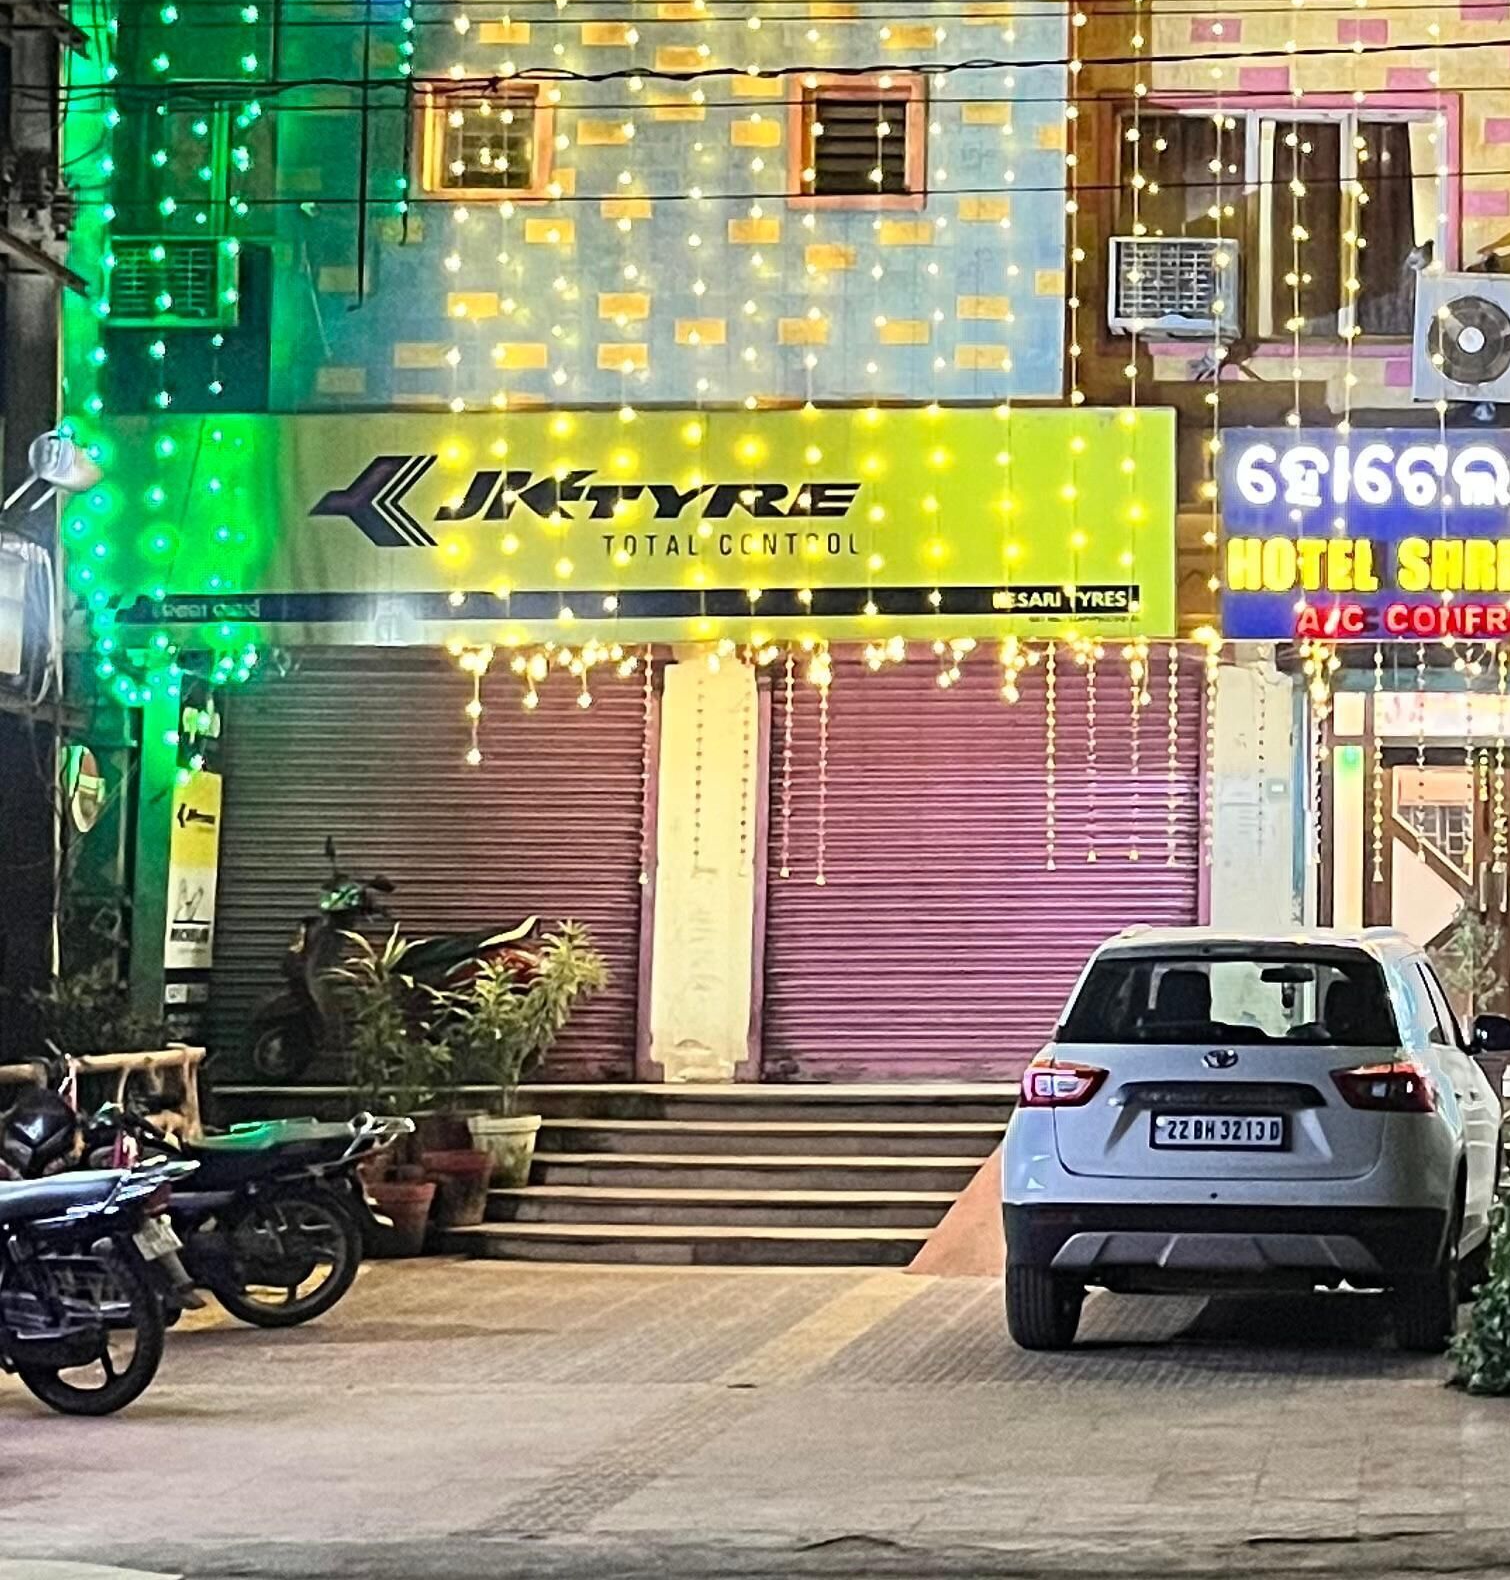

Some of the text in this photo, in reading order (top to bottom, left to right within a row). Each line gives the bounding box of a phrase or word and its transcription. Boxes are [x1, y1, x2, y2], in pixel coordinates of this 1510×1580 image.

[1236, 444, 1510, 507] ହୋଟେଲ
[602, 534, 699, 557] TOTAL
[1226, 538, 1378, 592] HOTEL
[993, 591, 1062, 608] ESARI
[1298, 603, 1365, 635] A/C
